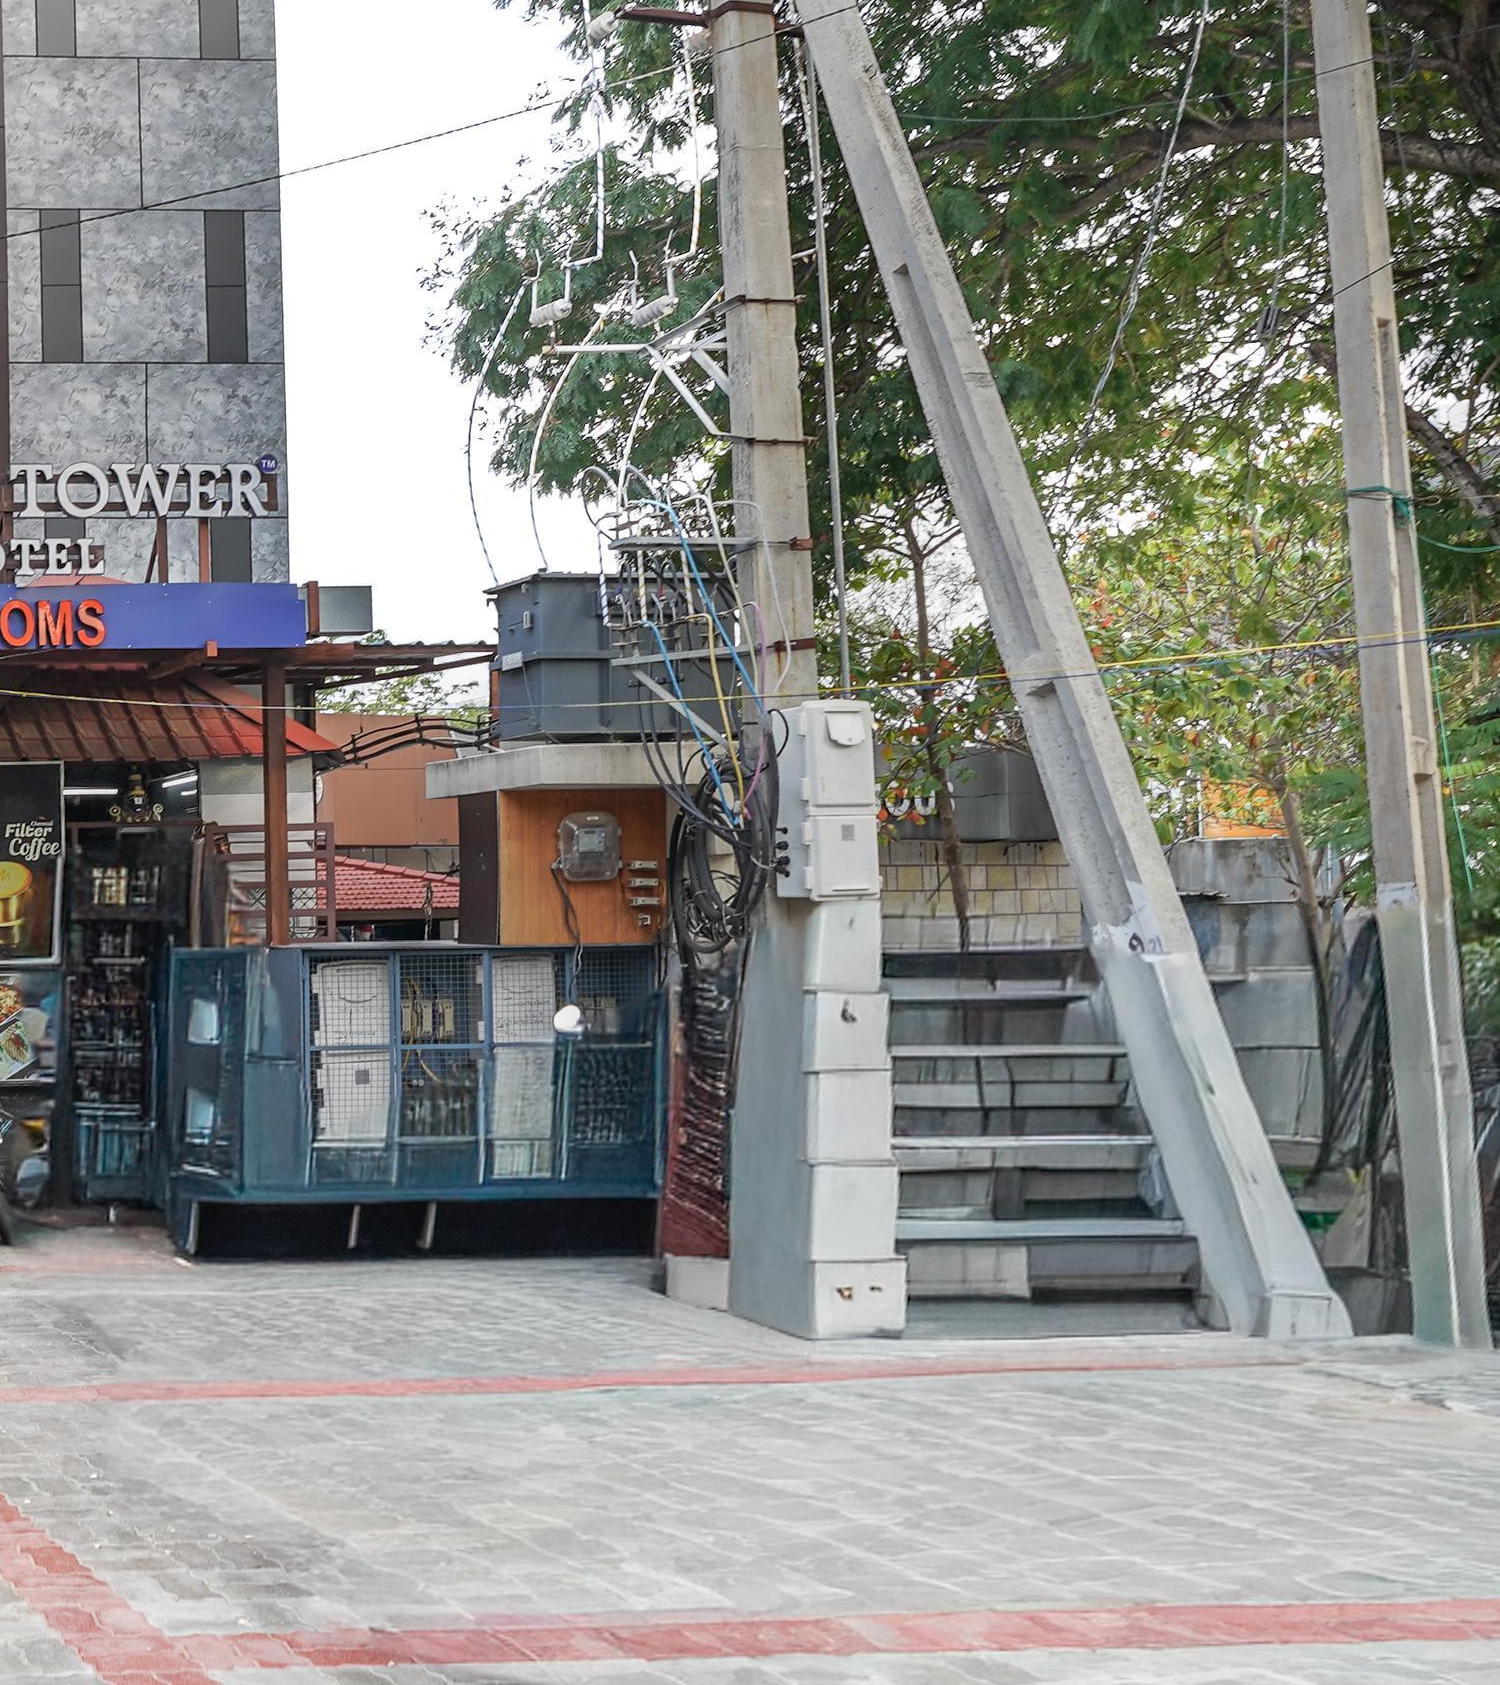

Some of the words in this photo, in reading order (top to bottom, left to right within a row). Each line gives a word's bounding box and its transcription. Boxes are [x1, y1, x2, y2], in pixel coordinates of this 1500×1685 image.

[9, 462, 270, 519] TOWER
[5, 822, 53, 838] Filter
[9, 837, 61, 862] Coffee
